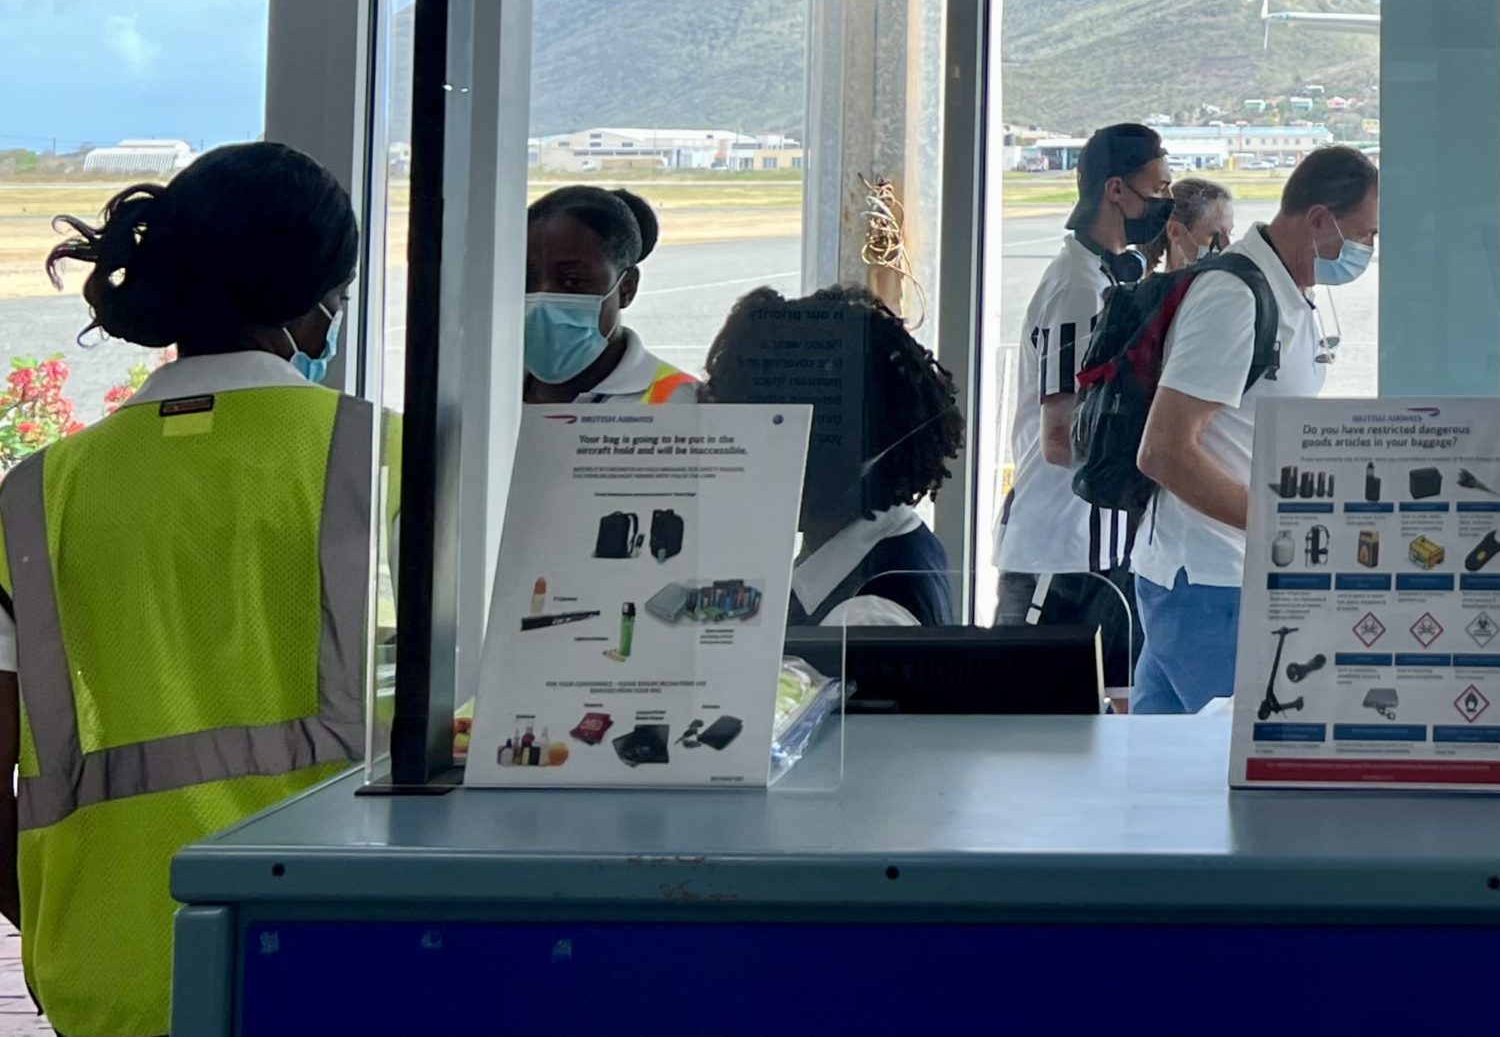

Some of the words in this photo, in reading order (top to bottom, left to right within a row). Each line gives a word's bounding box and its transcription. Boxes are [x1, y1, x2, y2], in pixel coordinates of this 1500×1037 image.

[1303, 424, 1317, 434] Do
[1320, 427, 1339, 436] you
[1341, 424, 1364, 434] have
[1367, 424, 1416, 434] restricted
[1418, 424, 1470, 436] dangerous
[579, 435, 600, 443] Your
[603, 435, 620, 445] bag
[622, 435, 630, 443] is
[633, 436, 659, 445] going
[674, 435, 686, 443] be
[688, 436, 704, 445] put
[707, 435, 716, 443] in
[719, 435, 734, 443] the
[1302, 436, 1332, 448] goods
[1335, 436, 1371, 447] articles
[1374, 436, 1384, 446] in
[1386, 439, 1408, 448] your
[1411, 435, 1458, 449] baggage?
[576, 446, 611, 455] aircraft
[612, 446, 635, 455] hold
[637, 446, 654, 455] and
[657, 446, 673, 455] will
[675, 446, 687, 455] be
